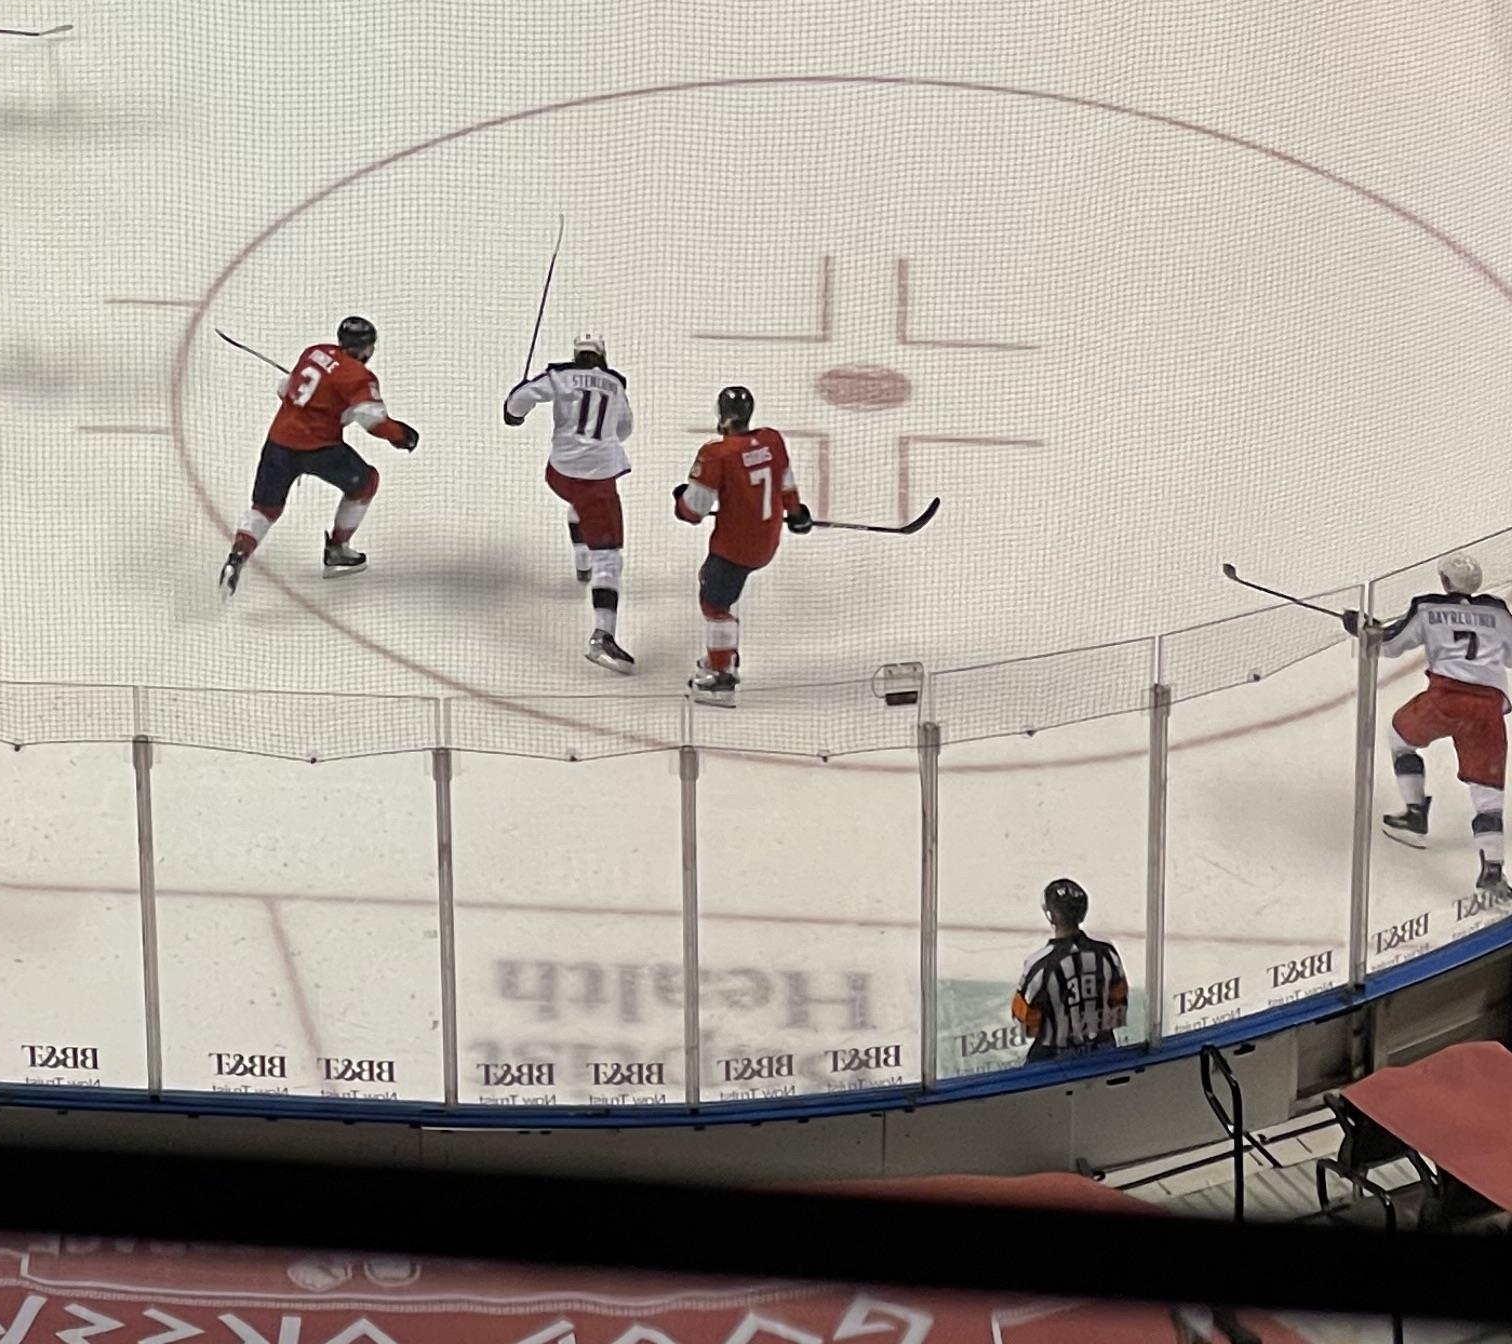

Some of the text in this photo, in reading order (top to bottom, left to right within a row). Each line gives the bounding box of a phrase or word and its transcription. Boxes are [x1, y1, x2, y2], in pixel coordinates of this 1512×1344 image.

[292, 366, 322, 408] 3
[576, 389, 610, 441] 11
[749, 467, 774, 521] 7
[1453, 630, 1479, 662] 7
